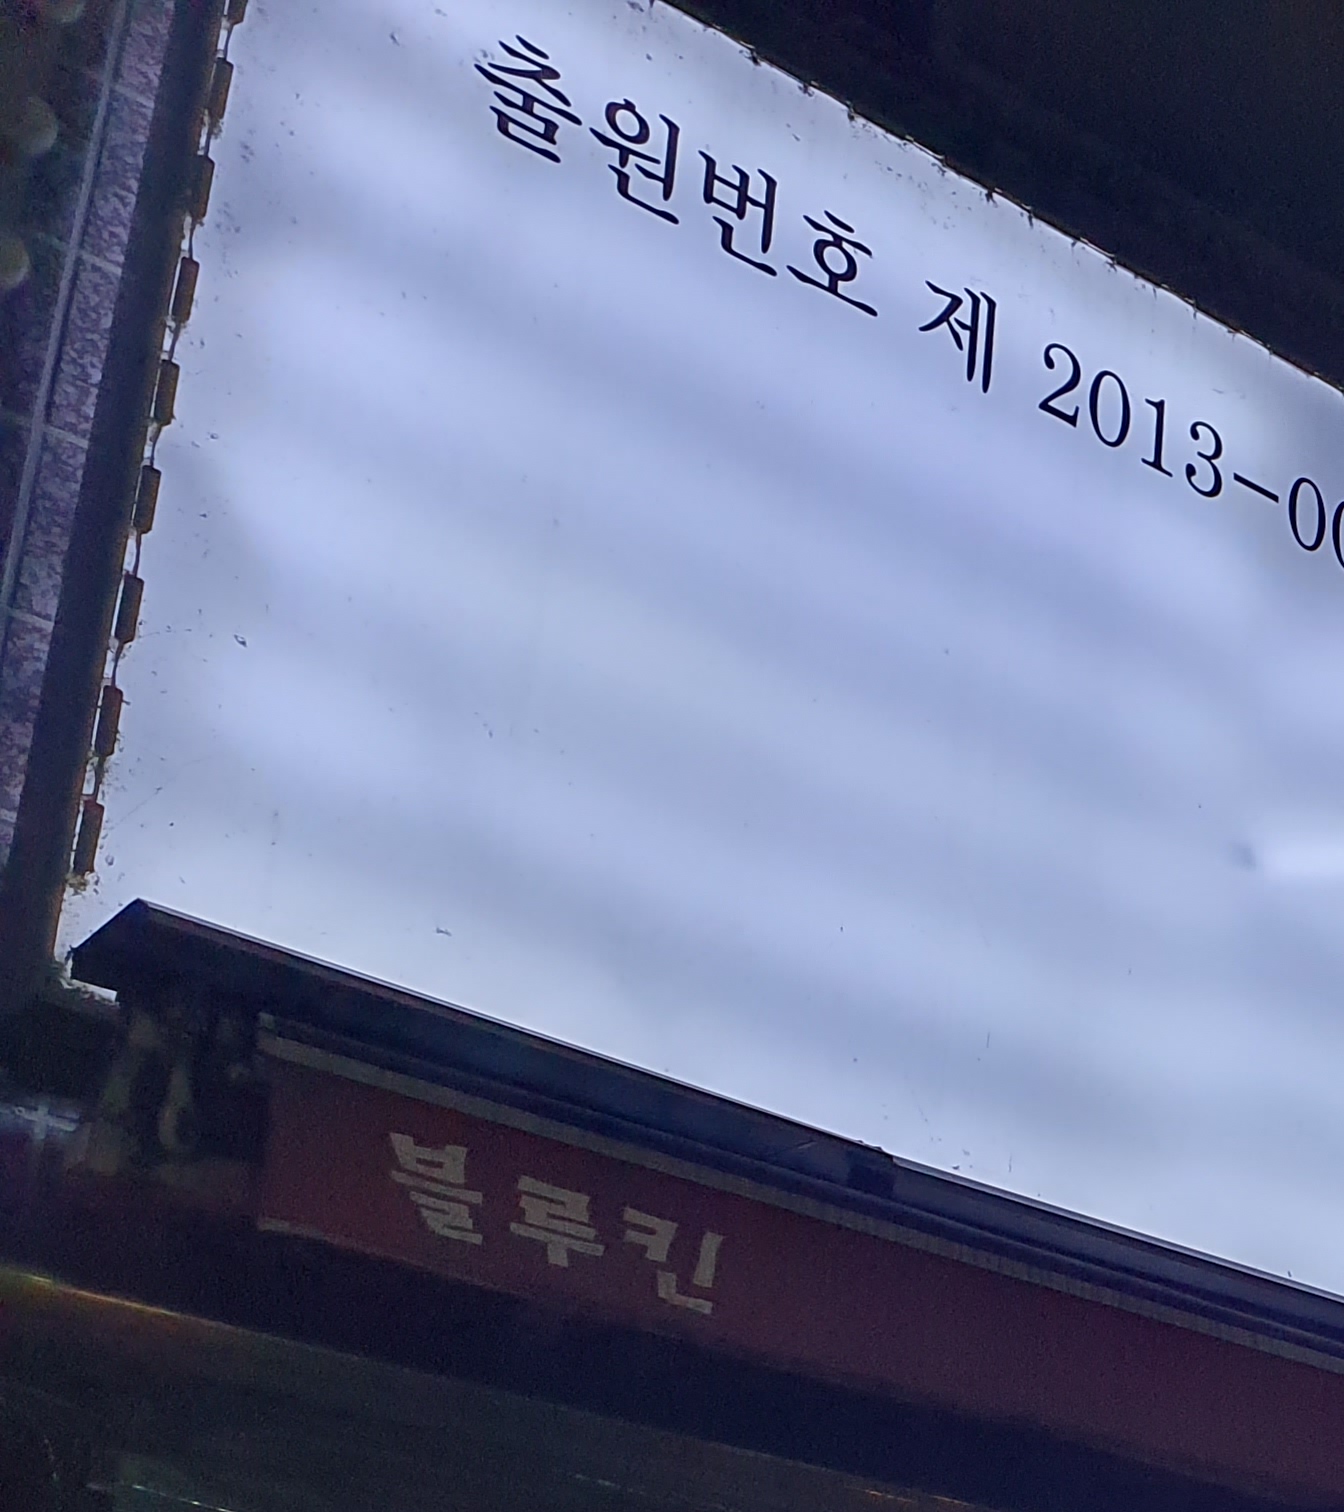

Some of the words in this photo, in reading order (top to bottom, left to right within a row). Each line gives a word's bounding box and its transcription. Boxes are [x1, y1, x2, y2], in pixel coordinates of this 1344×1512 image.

[474, 34, 879, 317] 출원번호
[919, 280, 997, 393] 제
[389, 1132, 725, 1315] 블루킨
